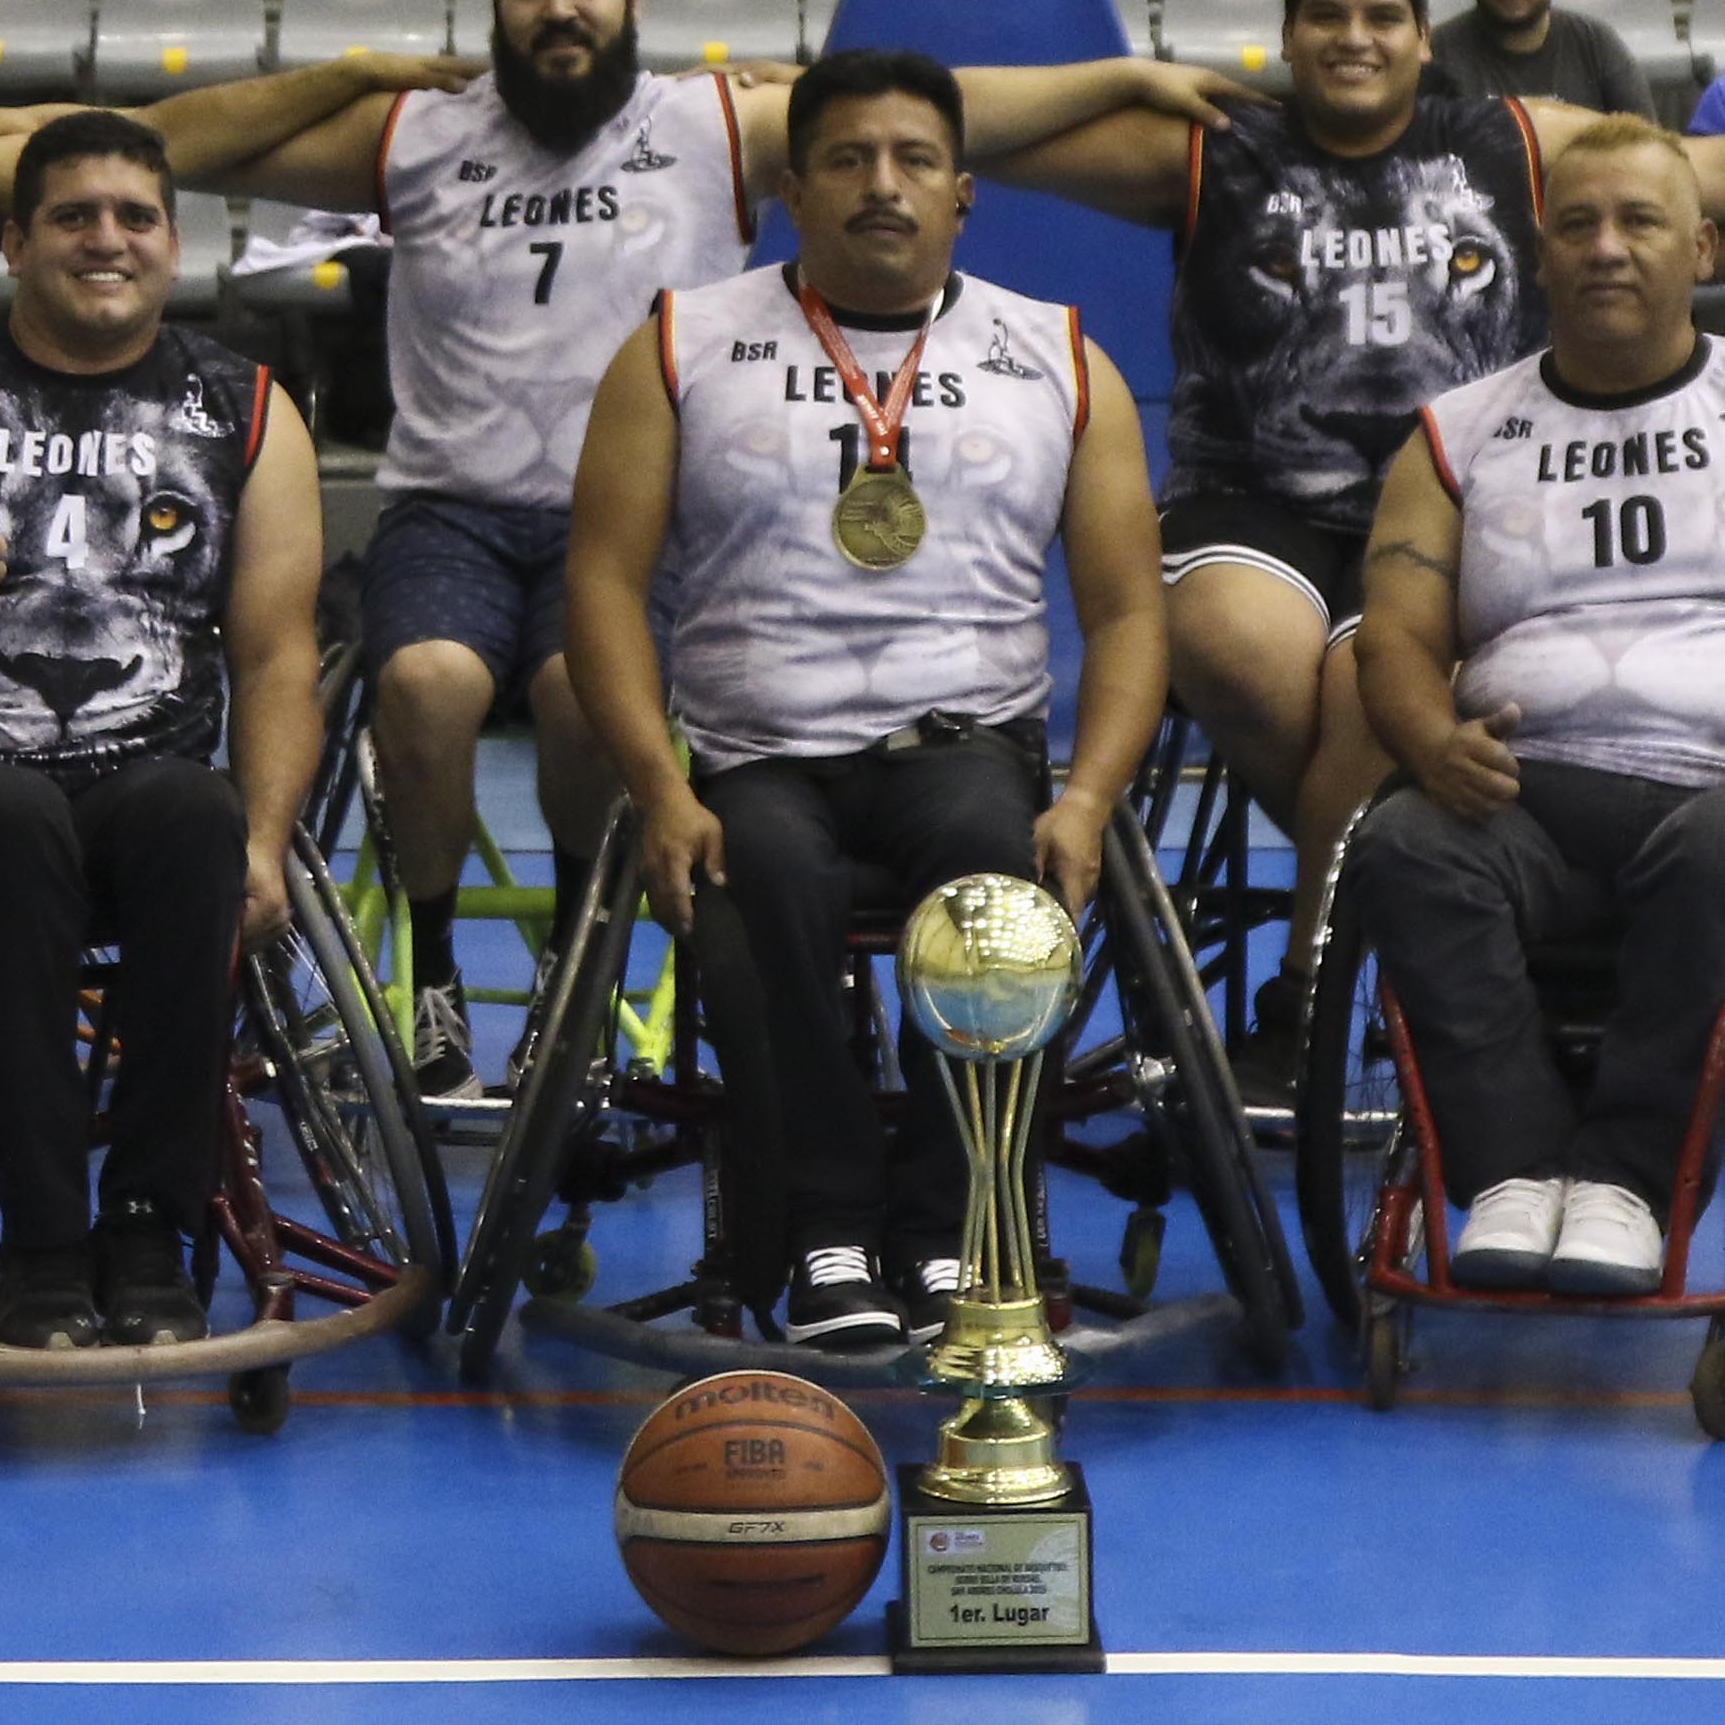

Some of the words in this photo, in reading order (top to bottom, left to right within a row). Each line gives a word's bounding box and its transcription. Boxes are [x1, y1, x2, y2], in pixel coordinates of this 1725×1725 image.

[480, 185, 620, 228] LEONES
[1300, 224, 1453, 269] LEONES
[529, 241, 563, 305] 7
[1338, 281, 1412, 346] 15
[731, 339, 778, 362] BSR
[784, 365, 967, 408] LENES
[1537, 426, 1711, 484] LEONES
[45, 493, 89, 570] 4
[1581, 494, 1667, 568] 10
[675, 1381, 836, 1421] molten
[724, 1438, 786, 1466] FIBA
[728, 1521, 786, 1534] GF7X
[950, 1604, 986, 1623] 1er.
[992, 1603, 1050, 1626] Lugar
